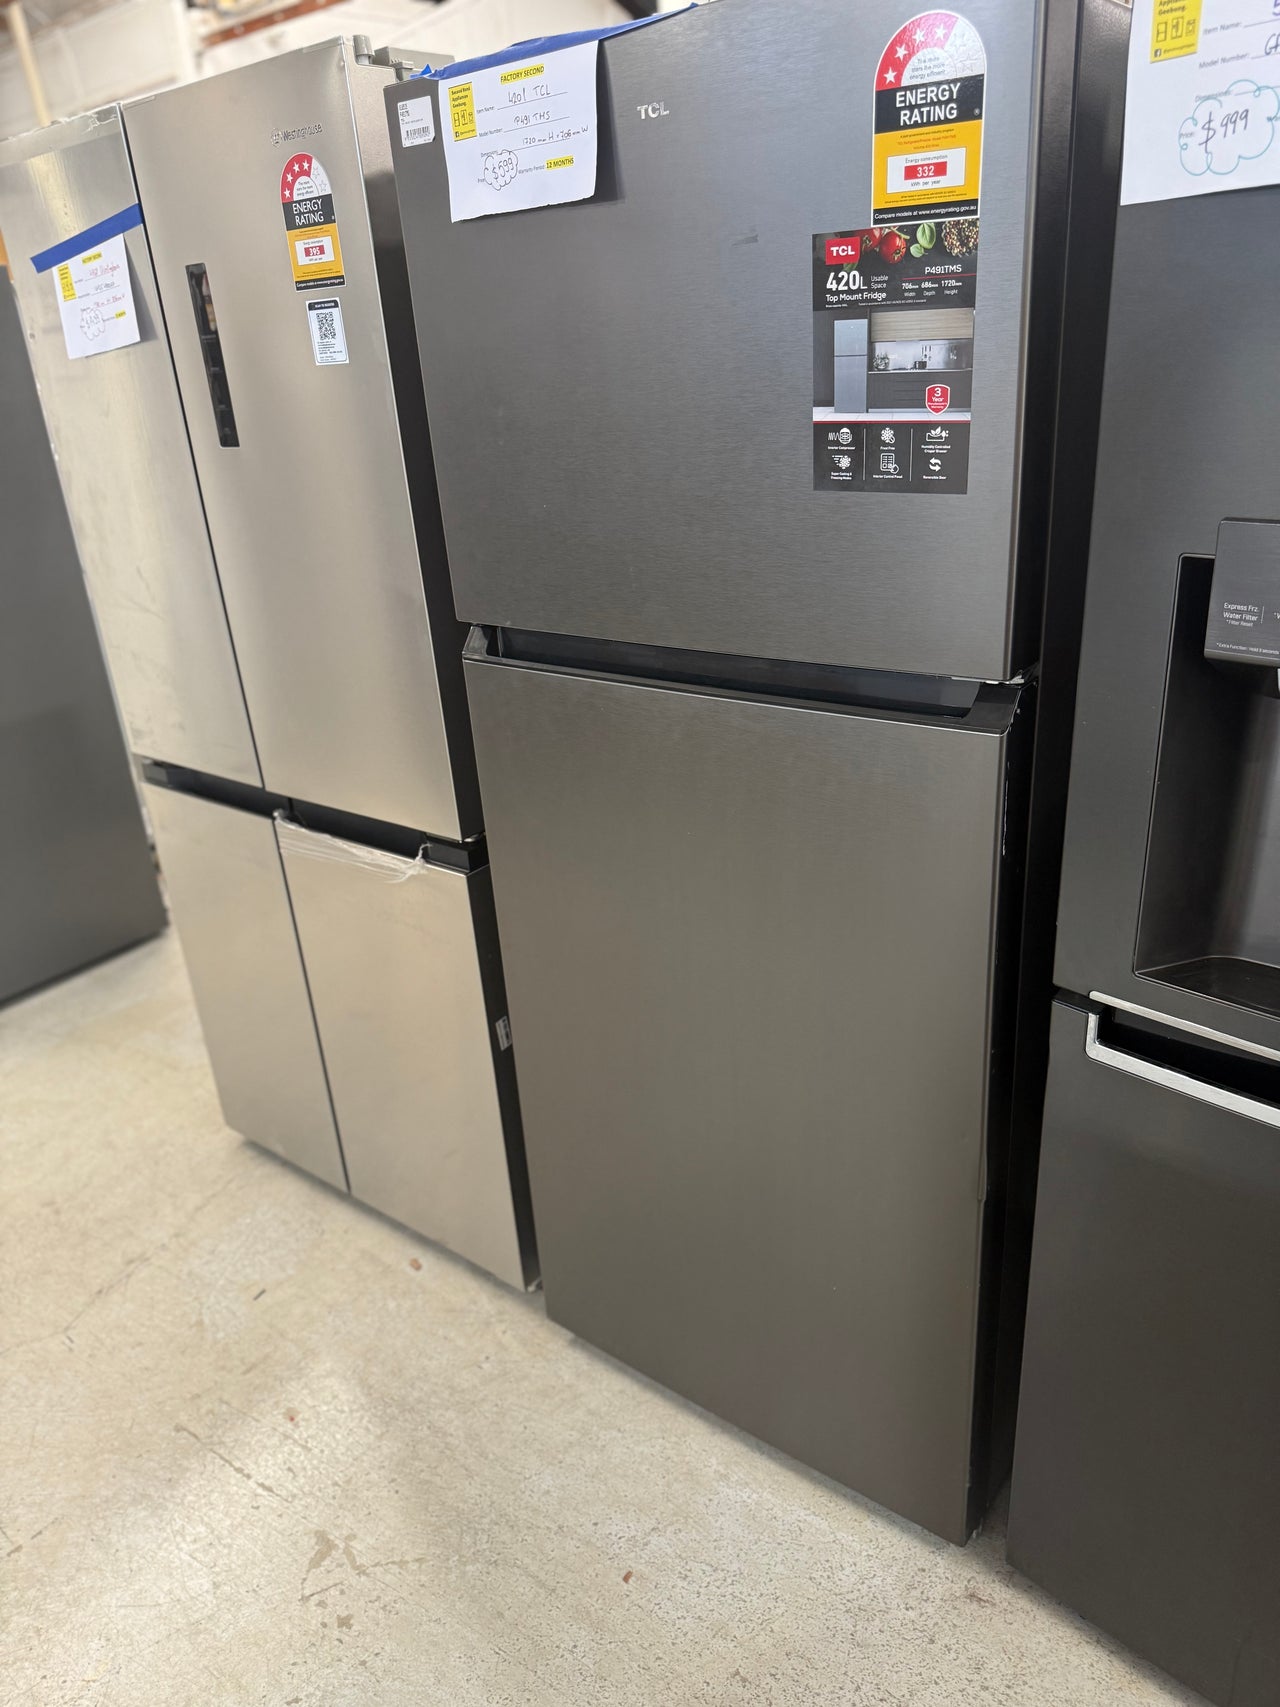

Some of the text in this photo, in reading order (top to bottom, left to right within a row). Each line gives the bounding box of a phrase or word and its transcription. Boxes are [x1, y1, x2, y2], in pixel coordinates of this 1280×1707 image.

[1203, 22, 1242, 35] Item Name:
[1198, 53, 1249, 69] Model Number:
[501, 66, 544, 82] FACTORY SECOND
[533, 84, 551, 96] TCL
[896, 83, 960, 107] ENERGY
[636, 102, 669, 120] TCL
[900, 103, 957, 126] RATING
[553, 158, 574, 167] MONTHS
[917, 166, 935, 178] 332
[293, 199, 322, 214] ENERGY
[295, 212, 324, 226] RATING
[309, 247, 320, 256] 395
[830, 246, 855, 257] TCL
[925, 264, 962, 274] P491TMS
[826, 271, 867, 291] 420L
[826, 291, 887, 303] Top Mount Fridge
[934, 387, 941, 397] 3
[1224, 603, 1247, 611] Express
